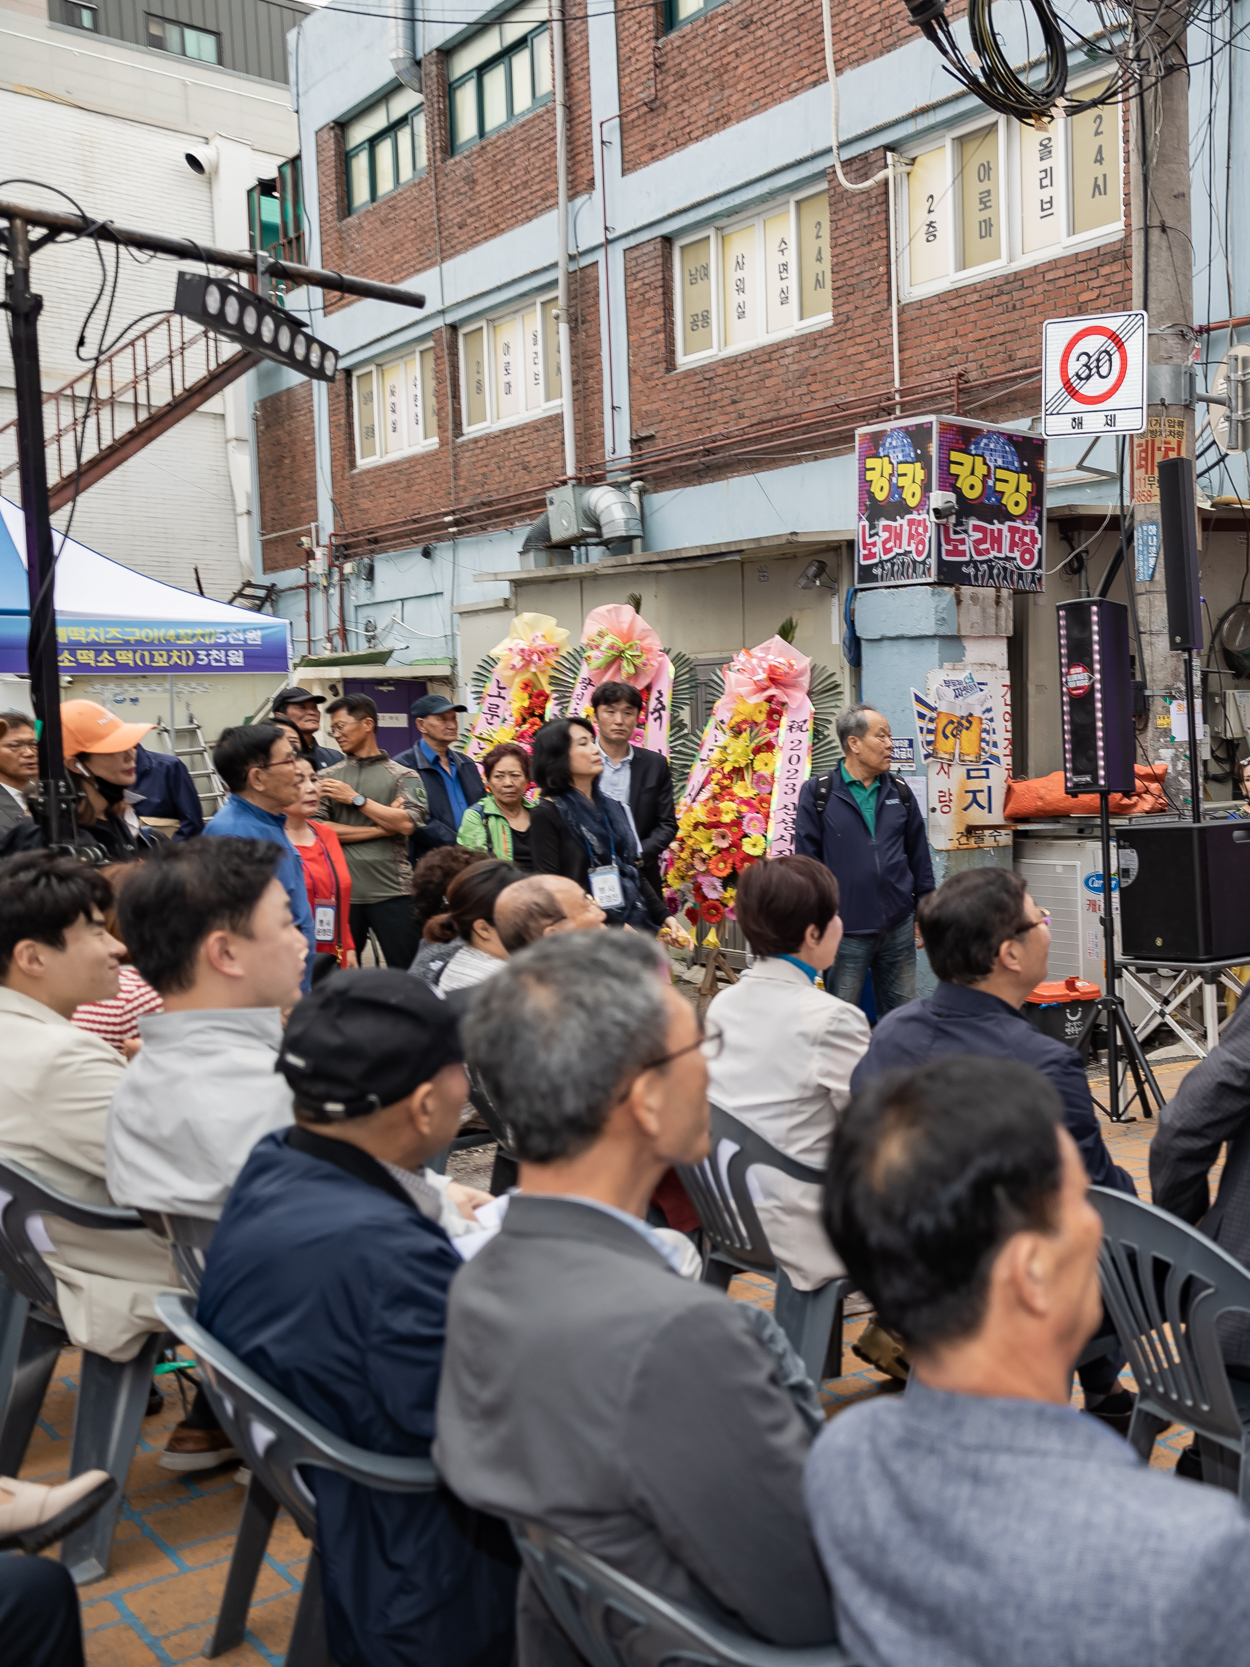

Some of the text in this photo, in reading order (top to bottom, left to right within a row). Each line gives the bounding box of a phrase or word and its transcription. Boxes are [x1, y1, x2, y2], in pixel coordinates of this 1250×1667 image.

[1037, 136, 1055, 220] 올리브
[1091, 112, 1108, 199] 24시
[924, 193, 938, 243] 2층
[976, 159, 994, 240] 아로마
[734, 254, 747, 320] 샤워실
[777, 236, 790, 306] 수면실
[1075, 349, 1113, 382] 30
[865, 456, 926, 508] 캉캉
[950, 451, 1033, 516] 캉캉
[784, 738, 803, 796] 2023
